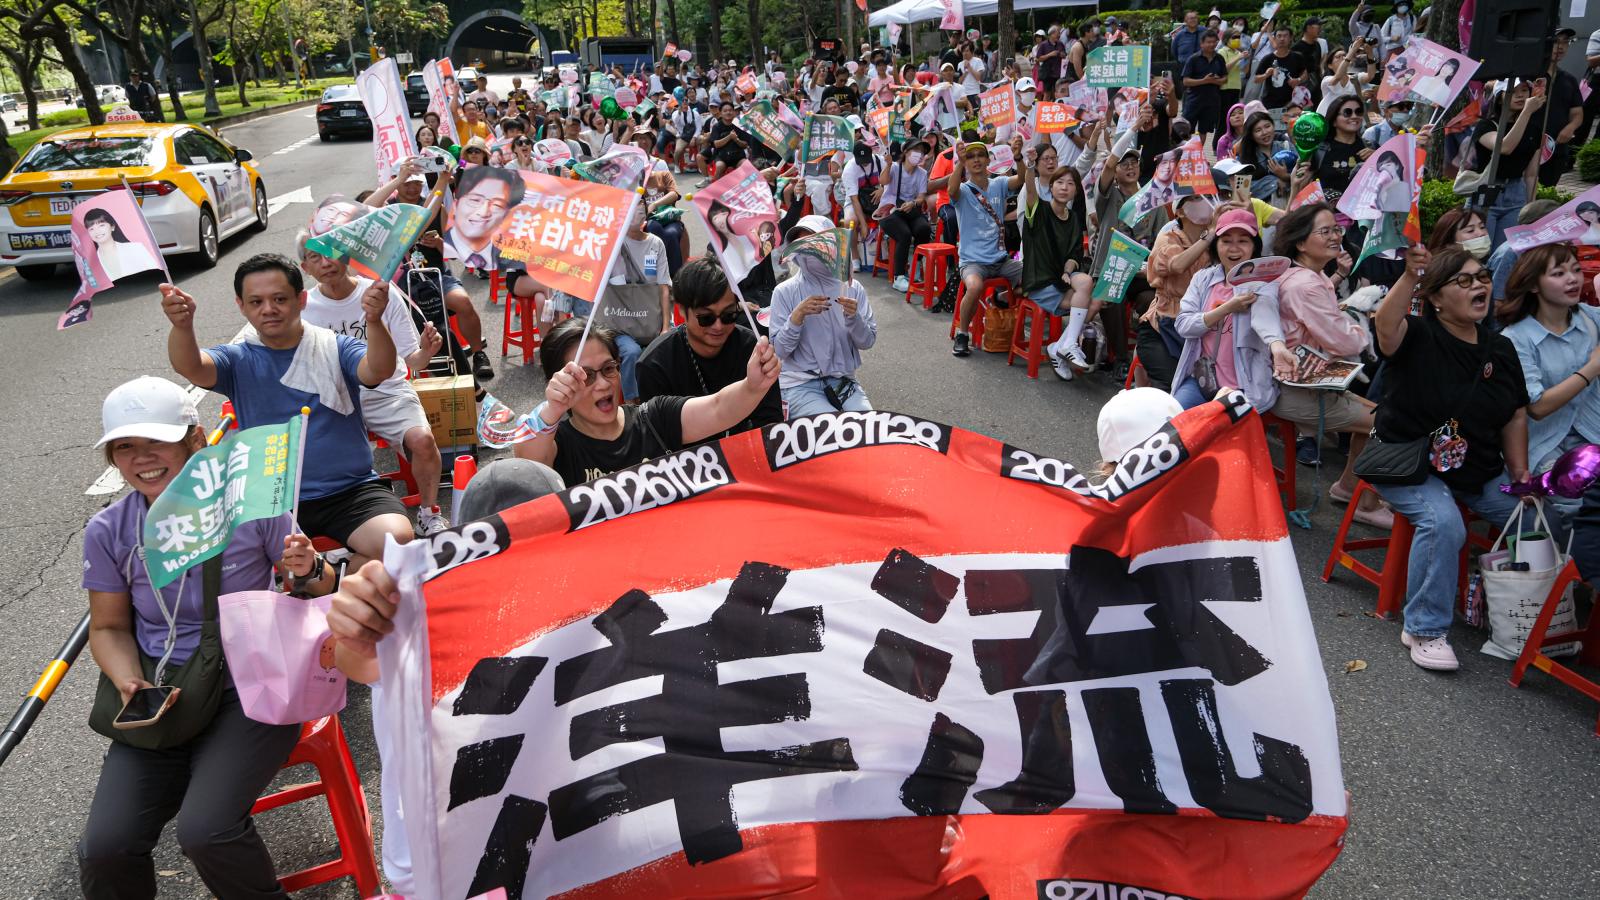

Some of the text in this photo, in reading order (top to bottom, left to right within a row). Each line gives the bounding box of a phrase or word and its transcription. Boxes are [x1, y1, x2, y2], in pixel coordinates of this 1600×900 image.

[810, 137, 850, 151] 順起來
[811, 120, 835, 135] 台北
[769, 411, 942, 468] 20261128
[570, 445, 730, 530] 20261128
[448, 546, 1314, 900] 洋流
